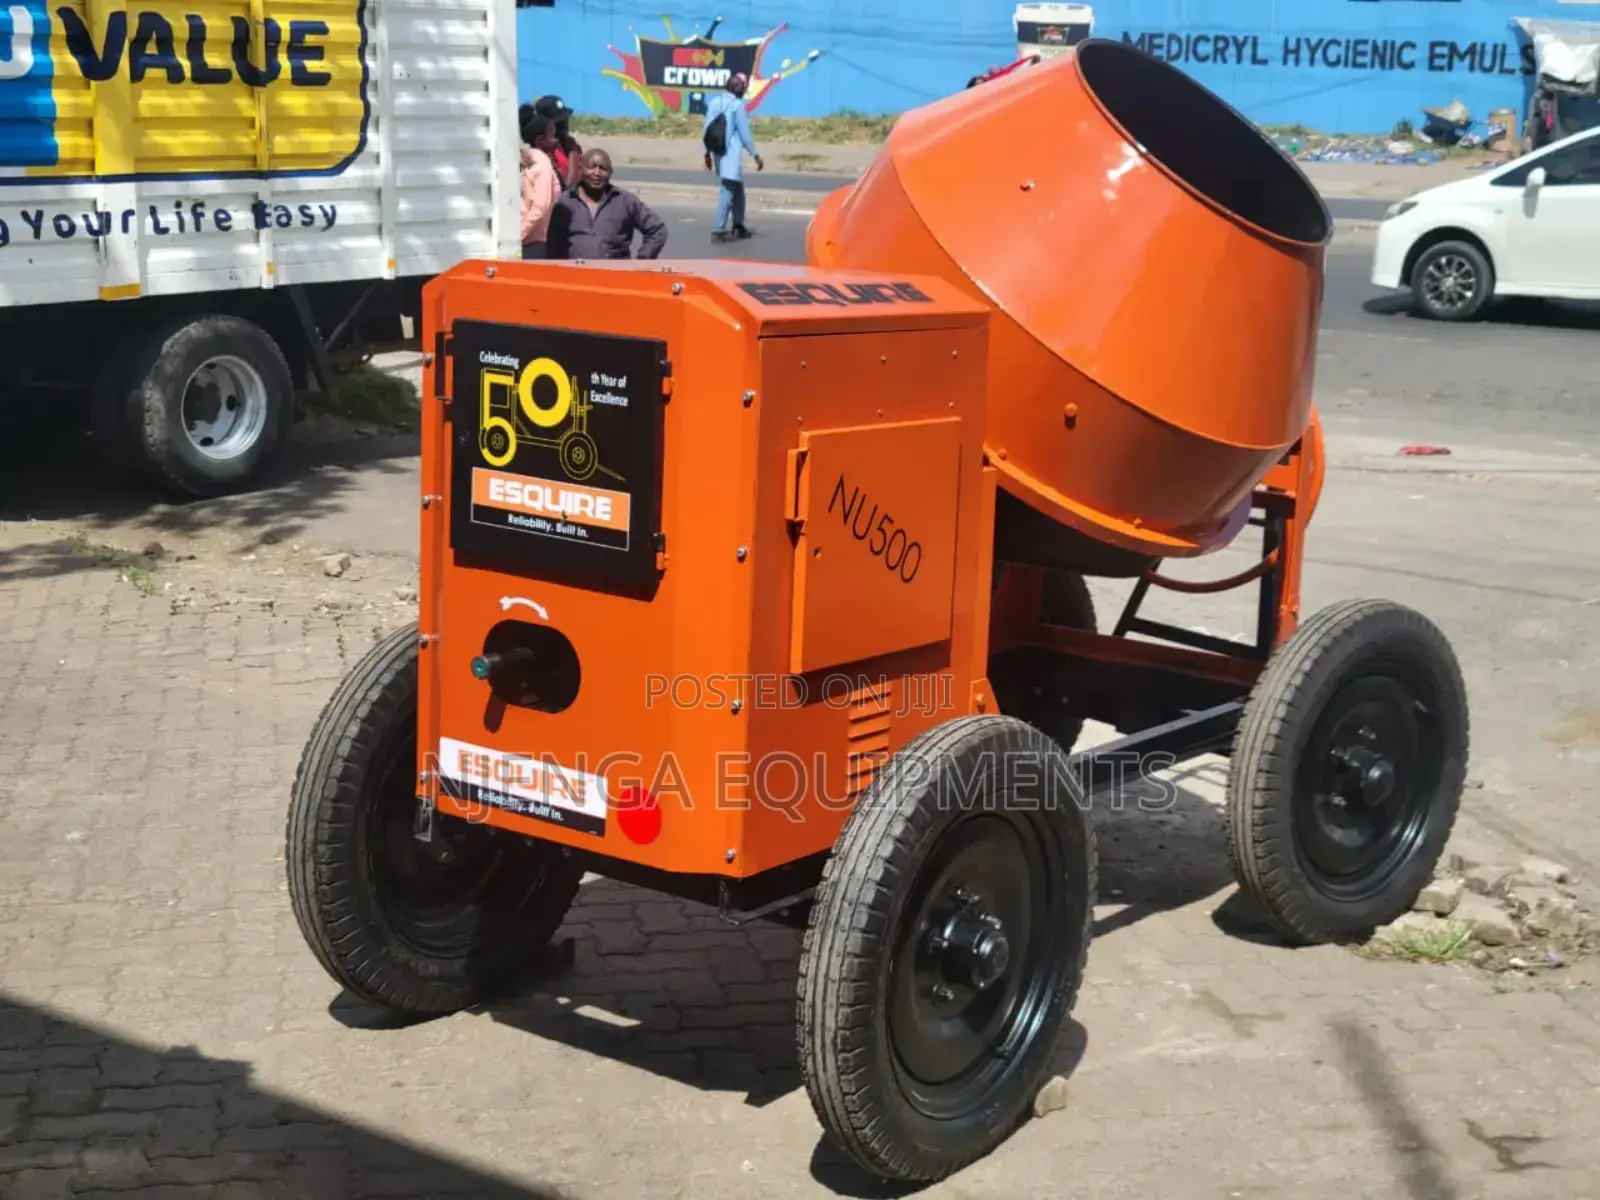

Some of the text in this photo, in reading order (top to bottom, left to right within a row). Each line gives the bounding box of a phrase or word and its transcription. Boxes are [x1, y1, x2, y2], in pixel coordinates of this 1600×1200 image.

[56, 6, 332, 88] VALUE
[1121, 31, 1269, 66] MEDICRYL
[1282, 36, 1417, 71] HYGIENIC
[663, 65, 731, 87] crown
[20, 208, 136, 240] Your
[149, 200, 232, 236] Life
[252, 199, 337, 232] Easy
[735, 282, 935, 307] ESQUIRE
[479, 350, 521, 370] Celebrating
[590, 371, 628, 389] th Year of
[590, 389, 630, 407] Excellence
[488, 477, 613, 521] ESQUIRE
[507, 513, 554, 532] Reliability.
[555, 522, 576, 537] Built
[827, 474, 922, 584] NU500
[457, 749, 587, 803] ESQUIRE
